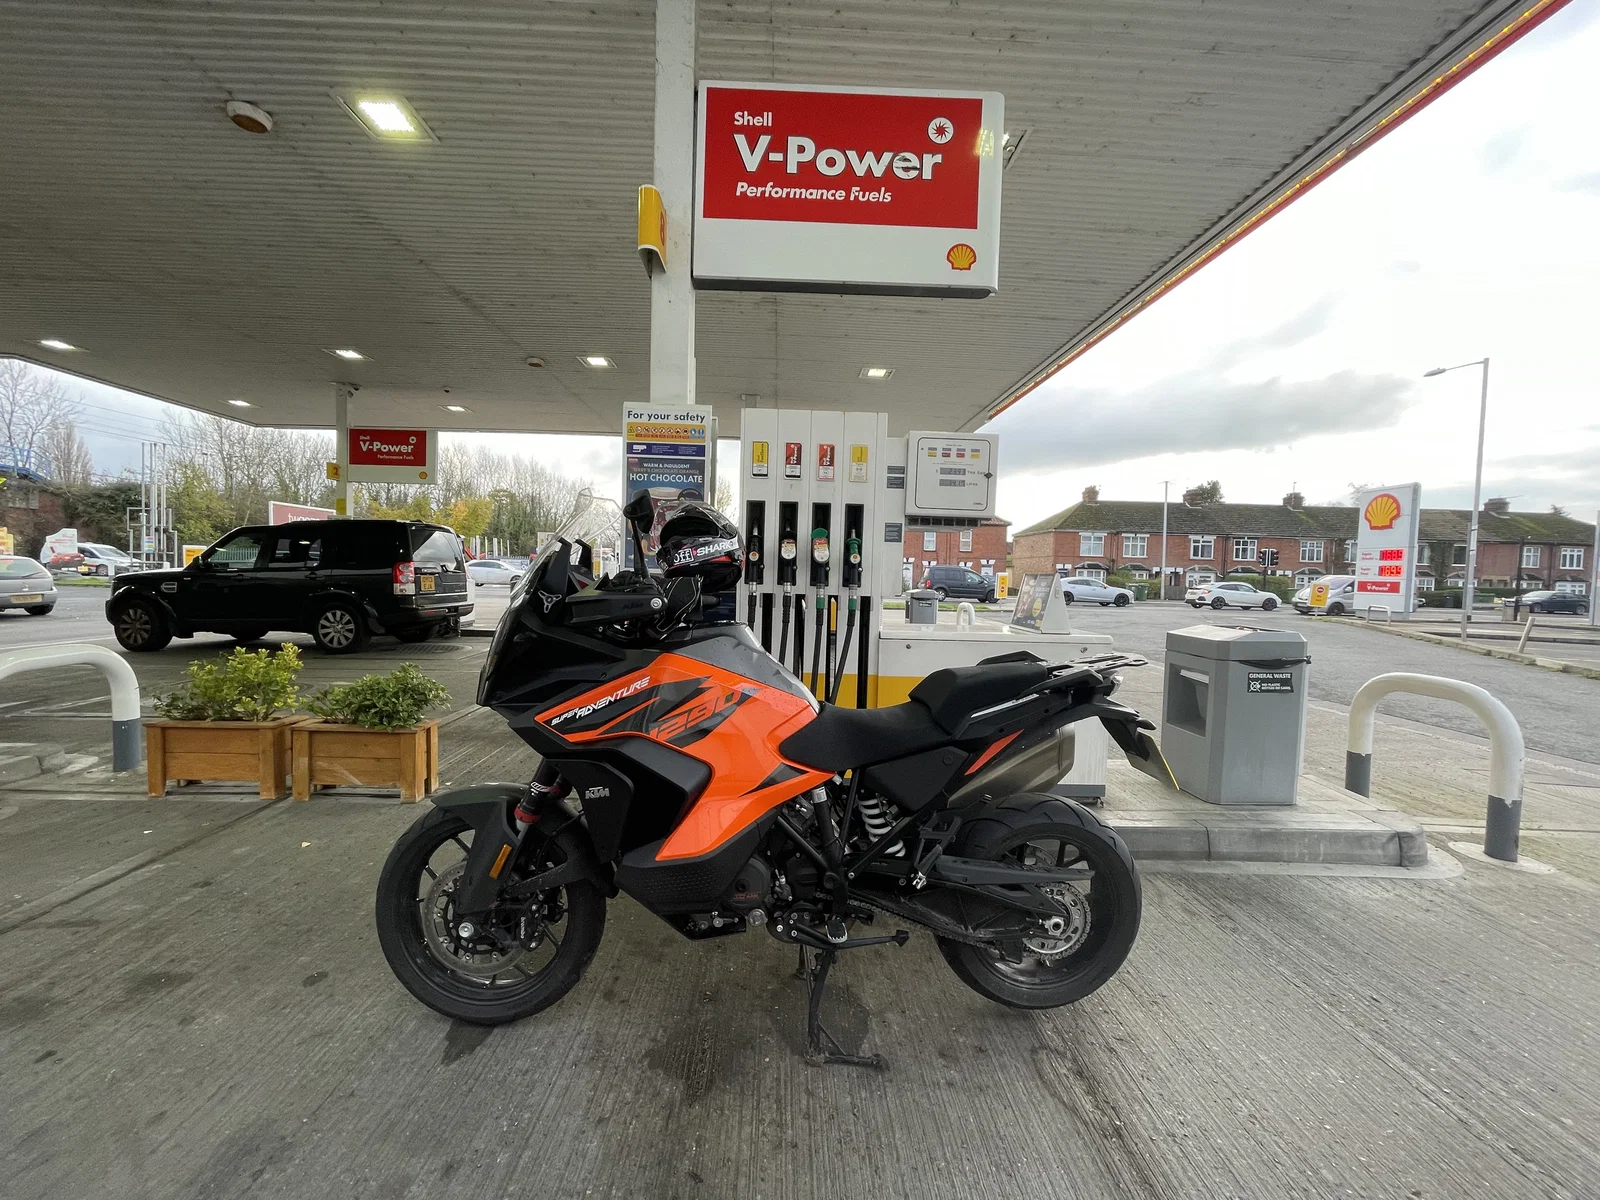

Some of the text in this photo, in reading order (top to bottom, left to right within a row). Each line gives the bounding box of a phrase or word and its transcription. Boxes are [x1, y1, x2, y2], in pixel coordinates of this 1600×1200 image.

[733, 112, 772, 126] Shell
[733, 133, 942, 180] V-Power
[736, 182, 891, 202] Performance Fuels
[627, 410, 705, 423] For your safety
[360, 441, 413, 452] V-Power
[629, 473, 703, 483] HOT CHOCOLATE
[697, 542, 731, 556] SHARK
[551, 676, 650, 726] SUPER ADVENTURE
[585, 786, 610, 799] KTM
